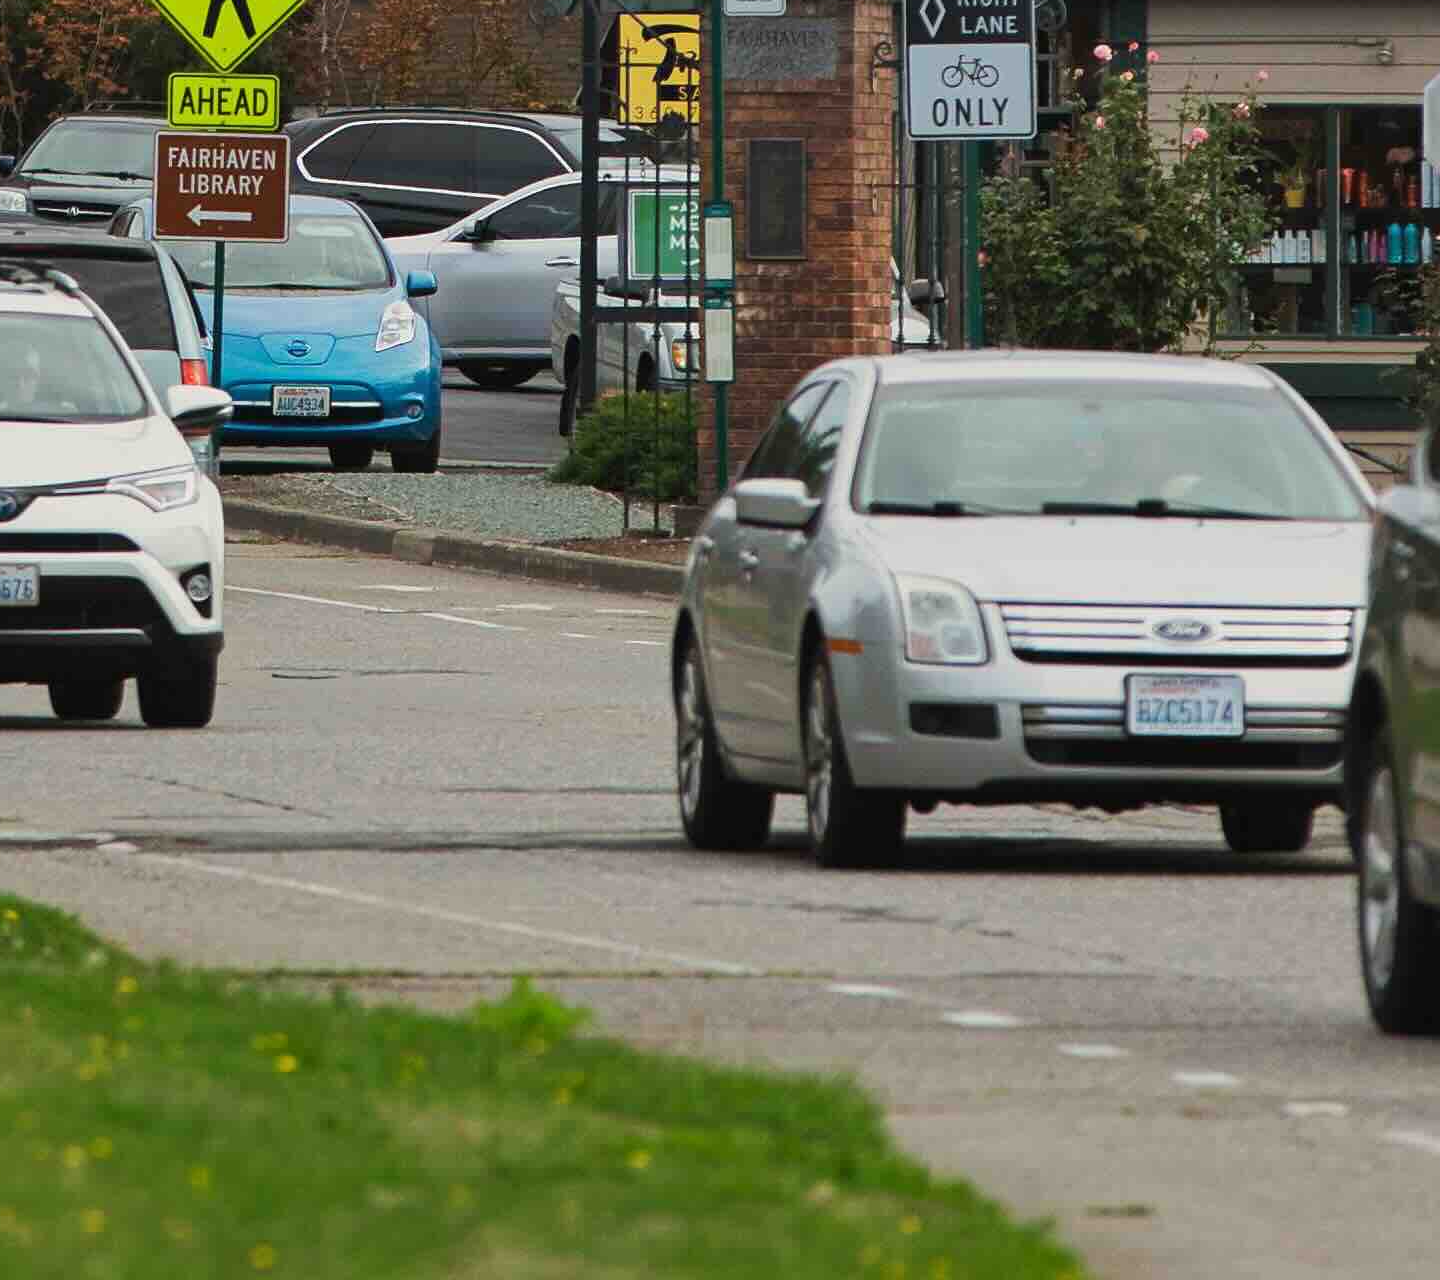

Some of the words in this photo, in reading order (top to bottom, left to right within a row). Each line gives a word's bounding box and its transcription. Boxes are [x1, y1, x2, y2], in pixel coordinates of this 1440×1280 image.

[961, 15, 1019, 34] LANE
[179, 87, 269, 117] AHEAD
[932, 97, 1009, 128] ONLY
[168, 146, 276, 171] FAIRHAVEN
[178, 173, 264, 196] LIBRARY
